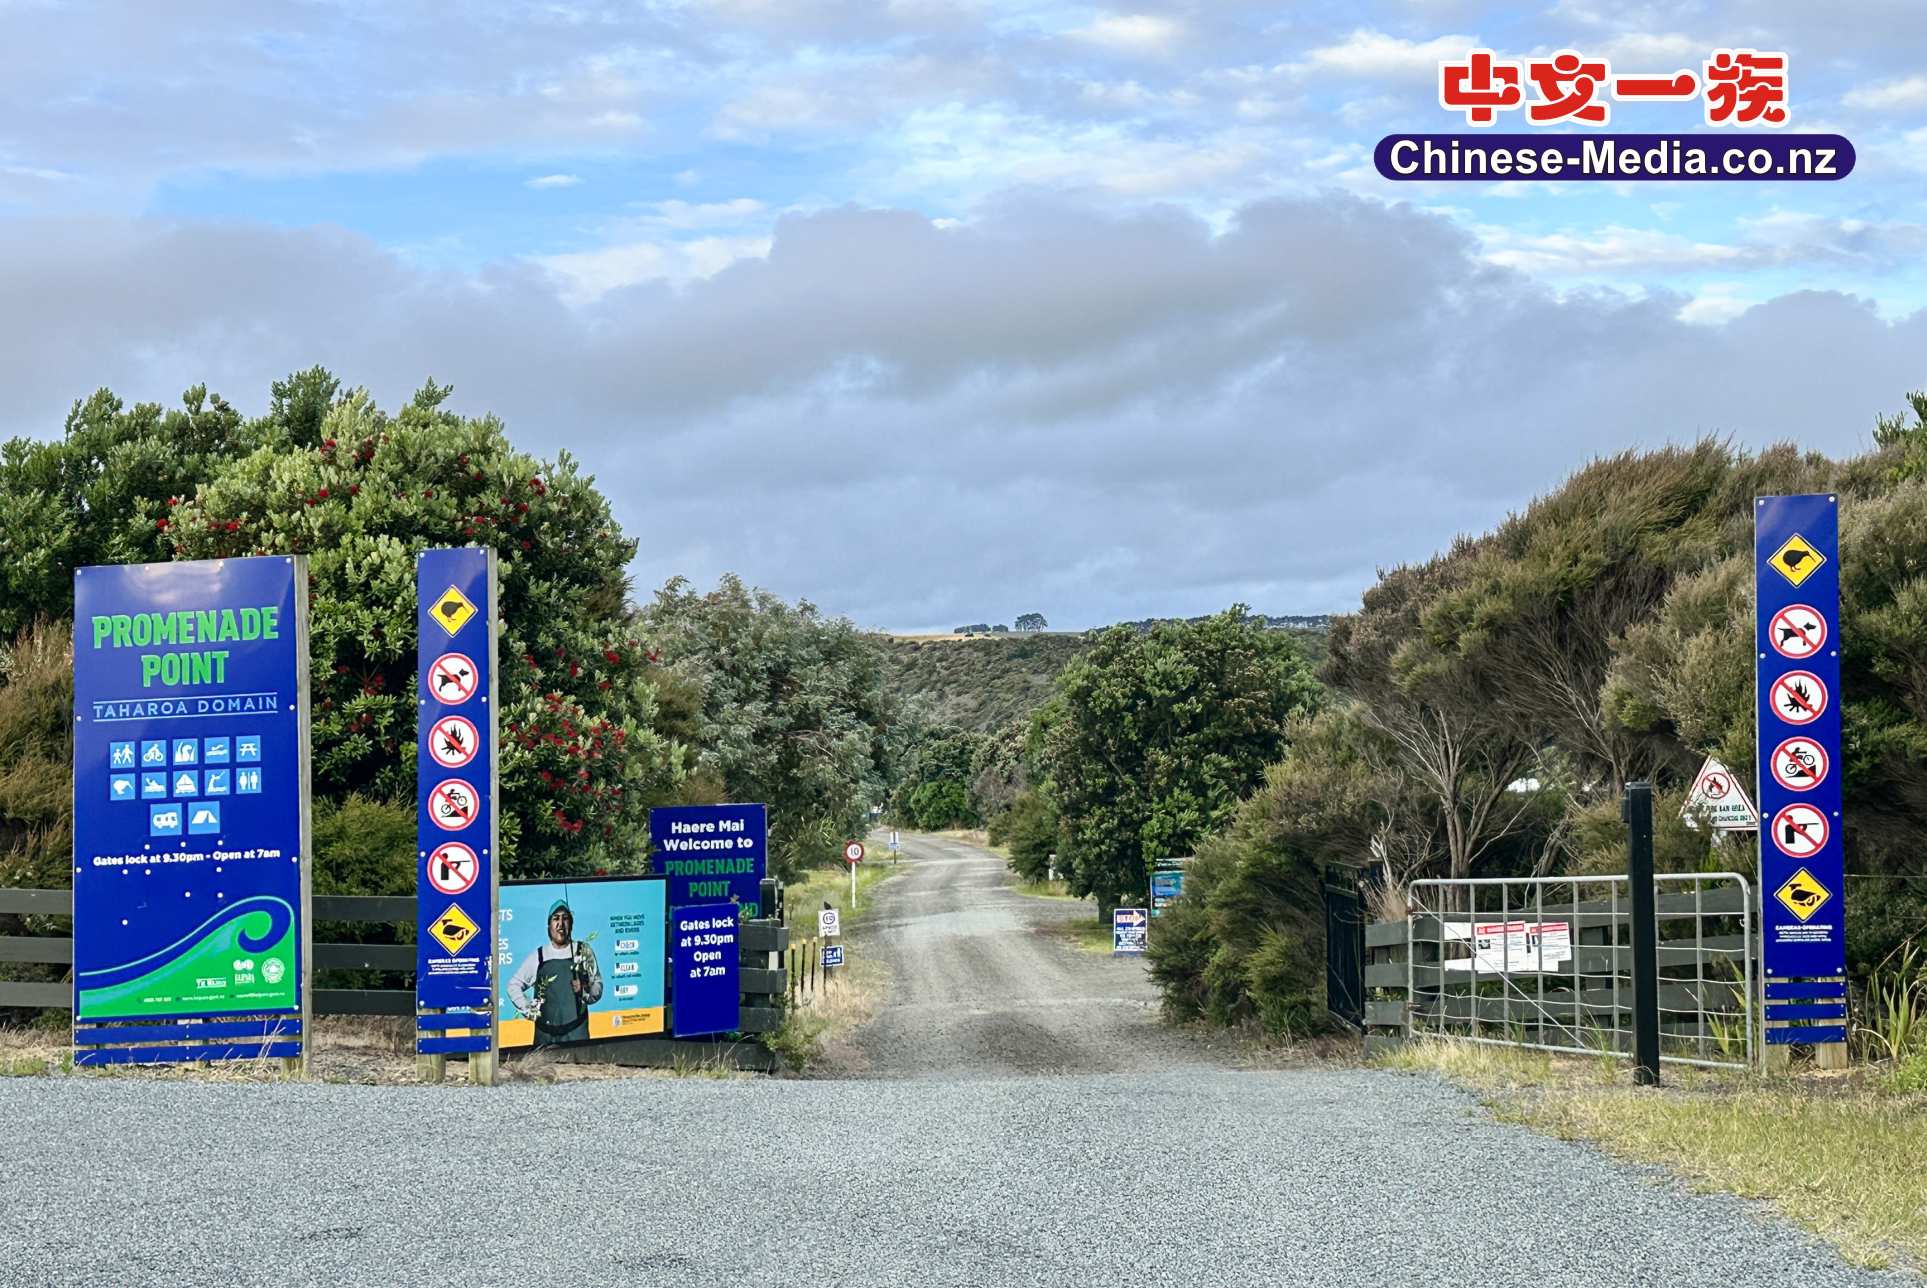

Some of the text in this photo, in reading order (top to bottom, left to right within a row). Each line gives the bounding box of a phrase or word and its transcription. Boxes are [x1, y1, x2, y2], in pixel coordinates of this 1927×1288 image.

[92, 606, 279, 649] PROMENADE
[141, 651, 229, 687] POINT
[93, 696, 278, 718] TAHAROA DOMAIN
[671, 819, 744, 834] Haere Mai
[663, 837, 753, 851] Welcome to
[850, 847, 859, 855] 10
[93, 856, 123, 866] Gates
[125, 854, 148, 864] lock
[149, 854, 161, 863] at
[163, 852, 204, 864] 9.30pm
[213, 850, 241, 861] Open
[243, 850, 255, 859] at
[257, 848, 280, 858] 7am
[665, 858, 754, 875] PROMENADE
[688, 880, 731, 898] POINT
[680, 916, 734, 931] Gates lock
[680, 934, 734, 948] at 9.30pm
[693, 951, 722, 964] Open
[690, 965, 726, 978] at 7am
